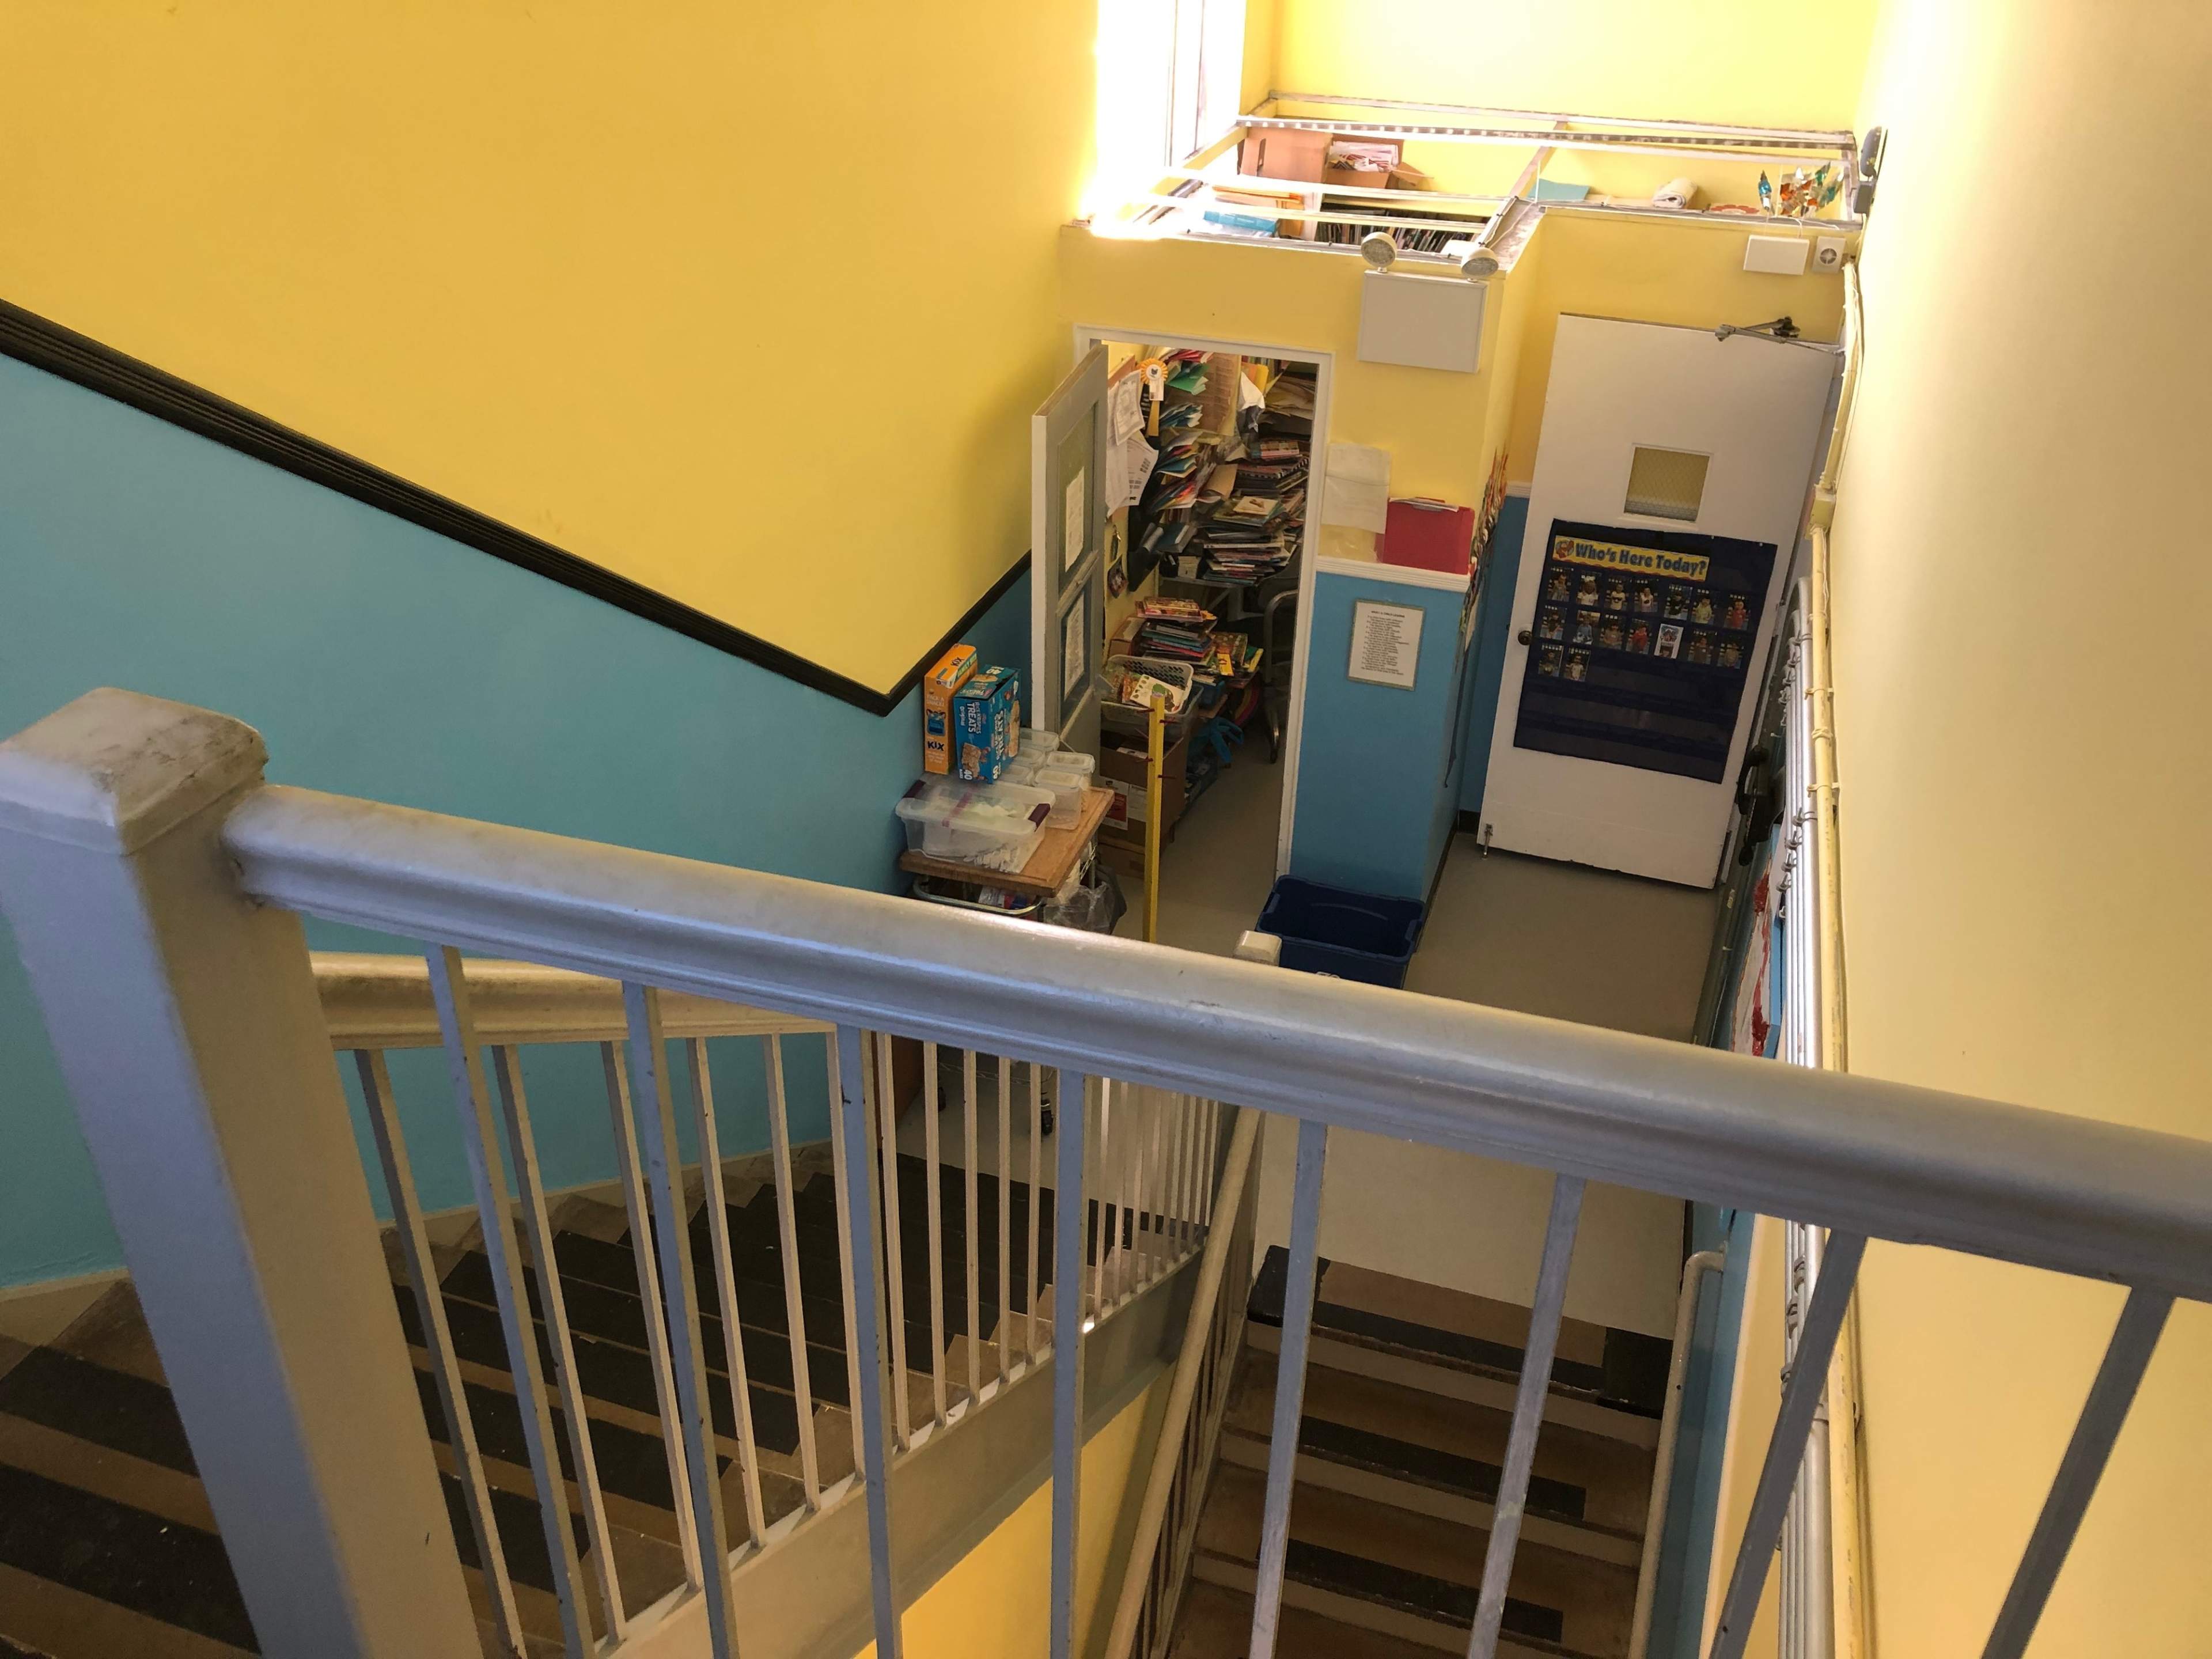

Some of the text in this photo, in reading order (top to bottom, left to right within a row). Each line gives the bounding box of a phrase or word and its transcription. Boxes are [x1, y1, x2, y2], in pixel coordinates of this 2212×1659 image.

[1575, 543, 1706, 577] Who's Here Today?
[967, 703, 976, 733] TREATS
[927, 741, 945, 751] KIX
[964, 769, 973, 780] 40
